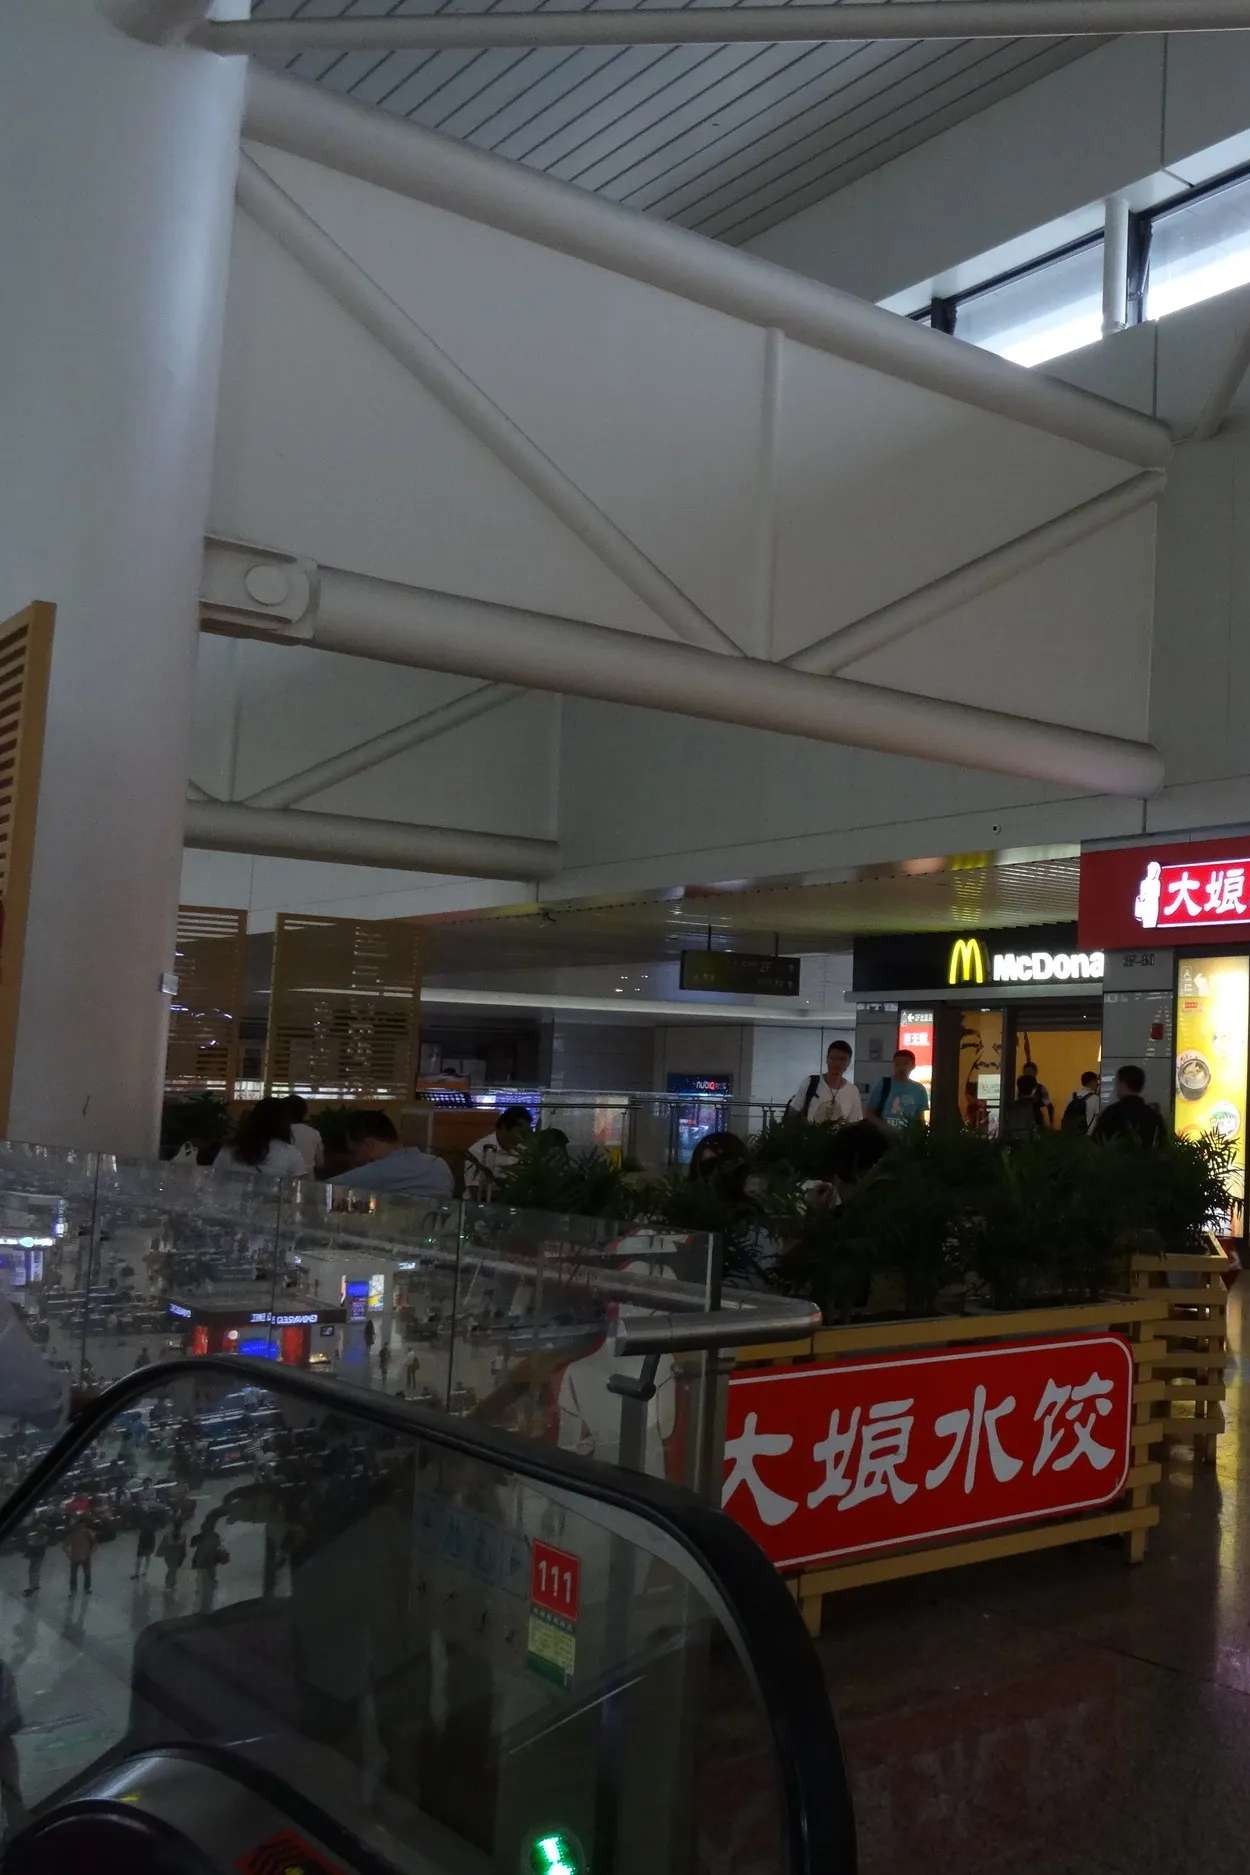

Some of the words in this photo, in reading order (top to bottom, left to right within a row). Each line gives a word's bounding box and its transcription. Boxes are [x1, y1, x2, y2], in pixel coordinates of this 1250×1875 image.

[721, 1371, 1116, 1527] 大娘水饺
[538, 1559, 572, 1604] 111
